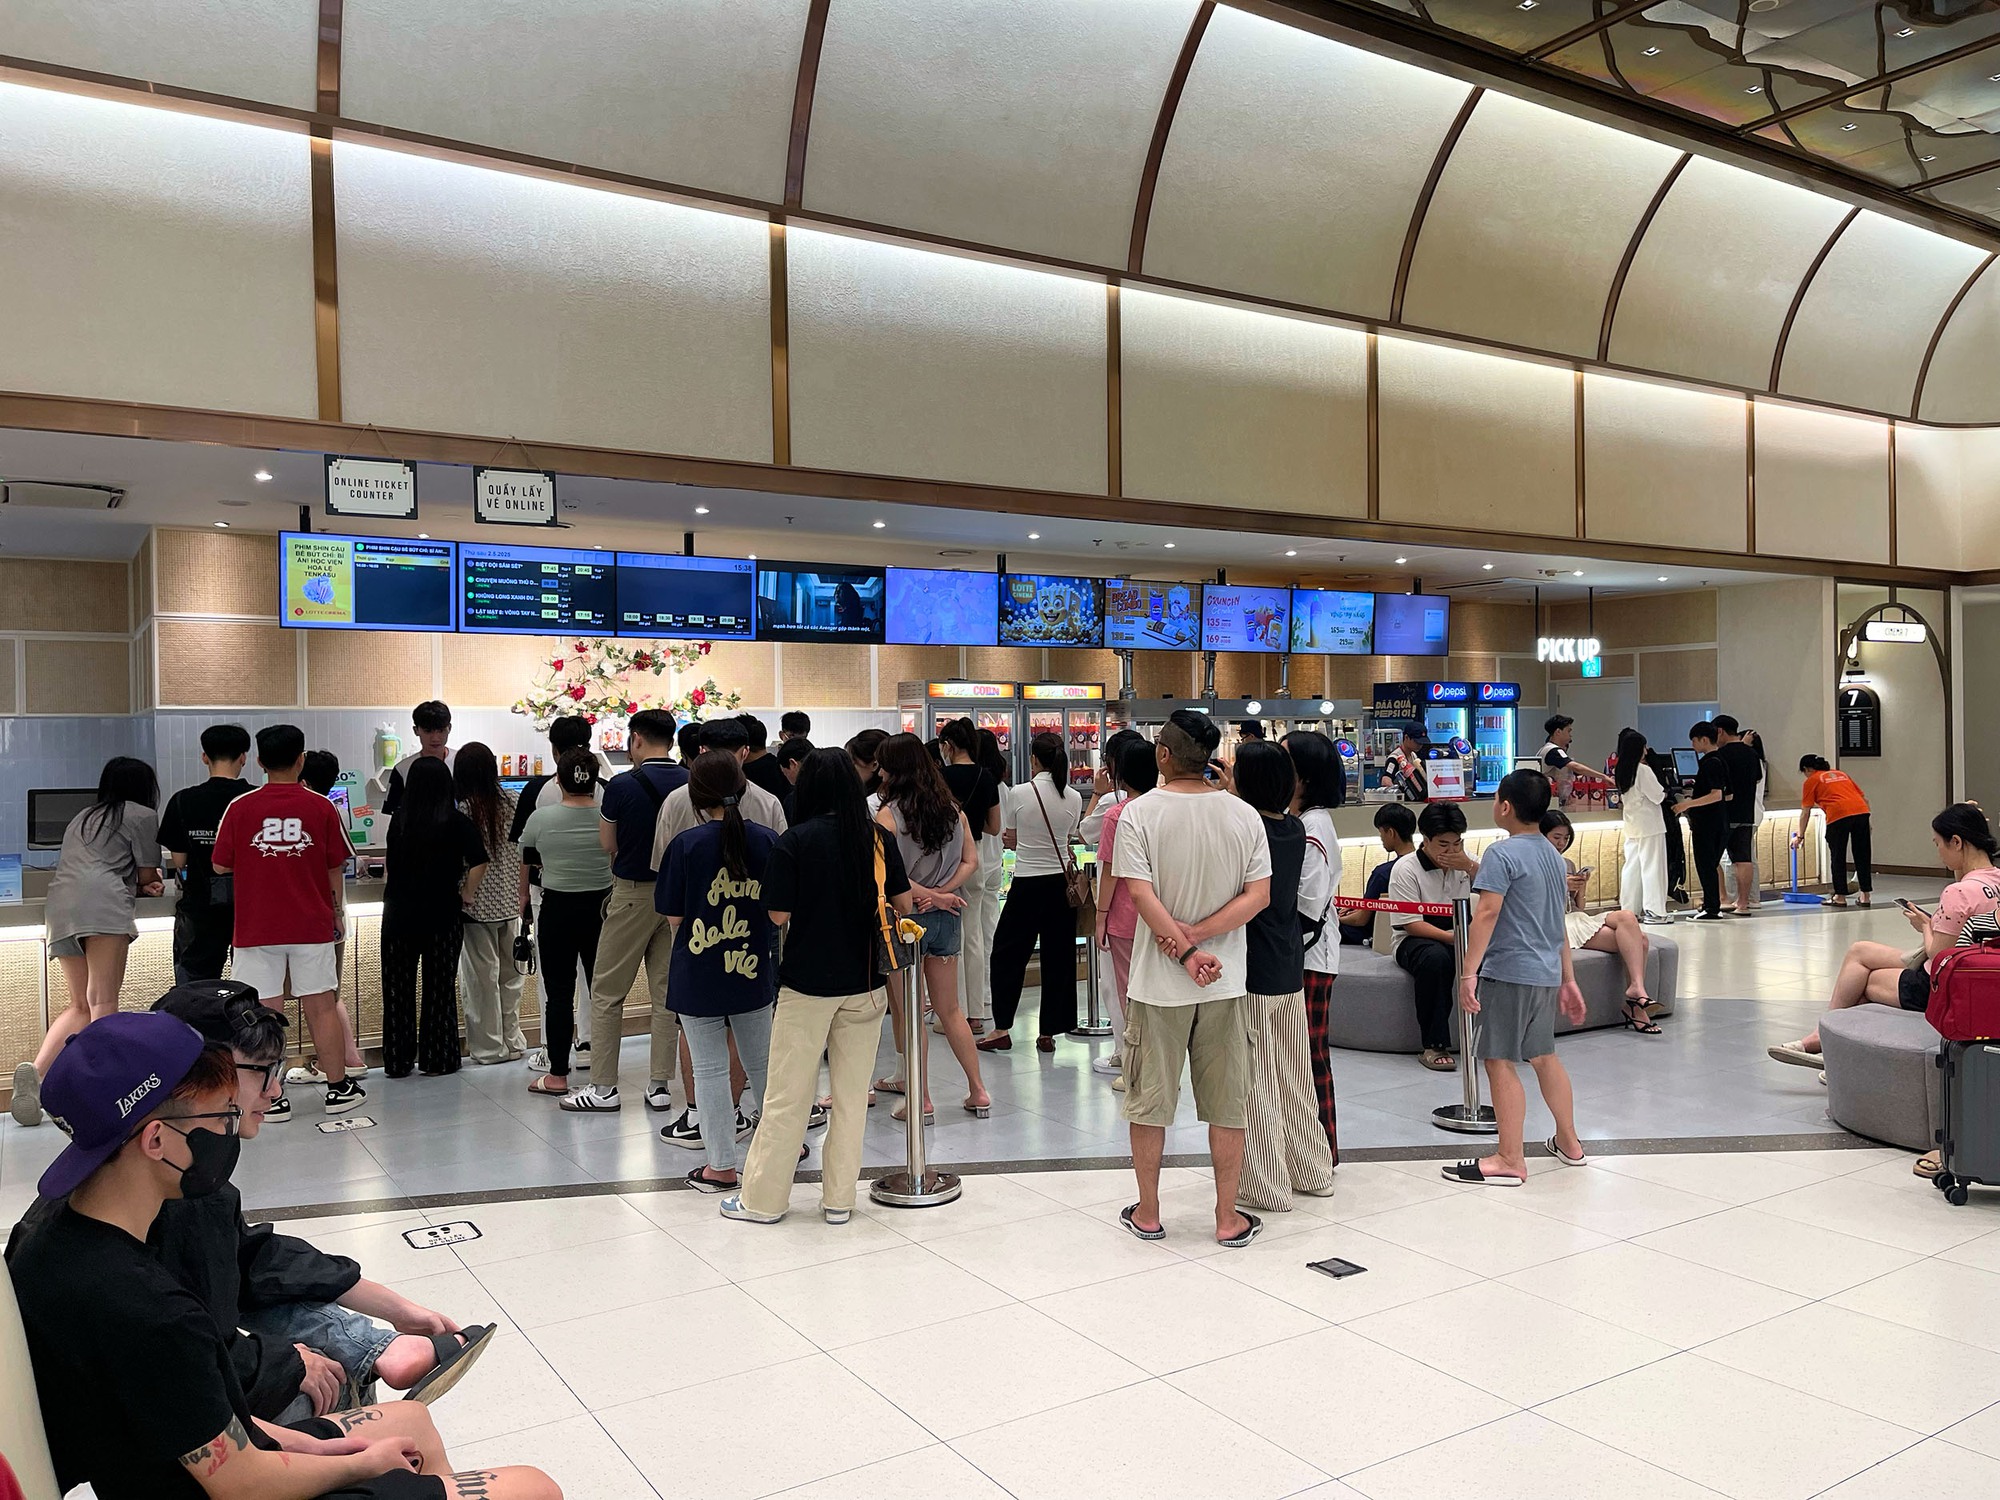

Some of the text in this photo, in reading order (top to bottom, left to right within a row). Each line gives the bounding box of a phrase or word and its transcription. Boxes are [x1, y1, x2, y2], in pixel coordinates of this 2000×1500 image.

[334, 476, 409, 490] ONLINE TICKET
[350, 490, 394, 500] COUNTER
[522, 484, 542, 497] LẤY
[486, 497, 545, 511] VÉ ONLINE
[1012, 583, 1034, 592] LOTTE
[1206, 618, 1220, 626] 135
[1206, 635, 1219, 643] 169
[1538, 637, 1600, 662] PICK UP
[1444, 686, 1466, 698] pepsi
[1493, 686, 1514, 698] pepsi
[1847, 690, 1859, 706] 7
[262, 818, 302, 842] 28
[1340, 898, 1399, 910] LOTTE CINEMA
[724, 943, 758, 979] vie
[115, 1072, 162, 1119] LAKERS
